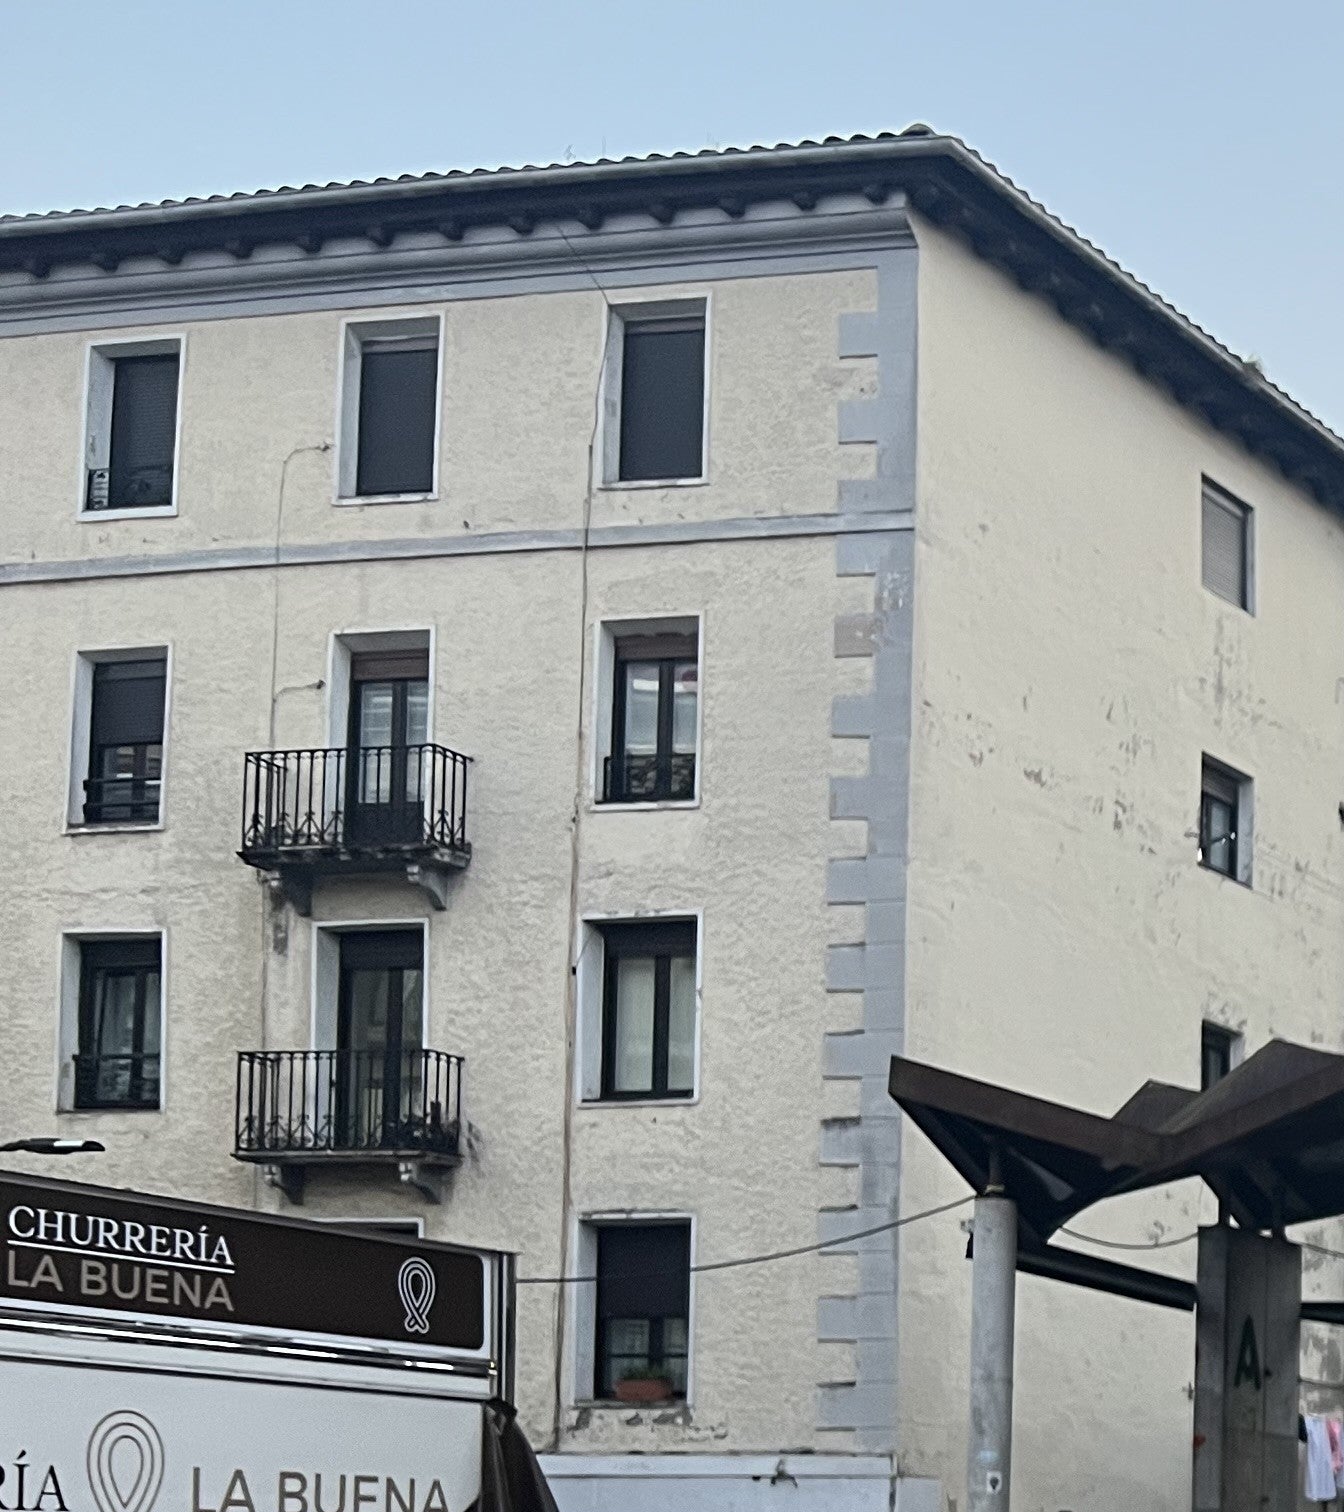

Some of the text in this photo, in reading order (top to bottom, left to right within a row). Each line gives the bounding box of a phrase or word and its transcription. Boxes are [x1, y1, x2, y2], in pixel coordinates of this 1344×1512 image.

[8, 1205, 235, 1266] CHURRERÍA
[8, 1250, 235, 1312] LA BUENA
